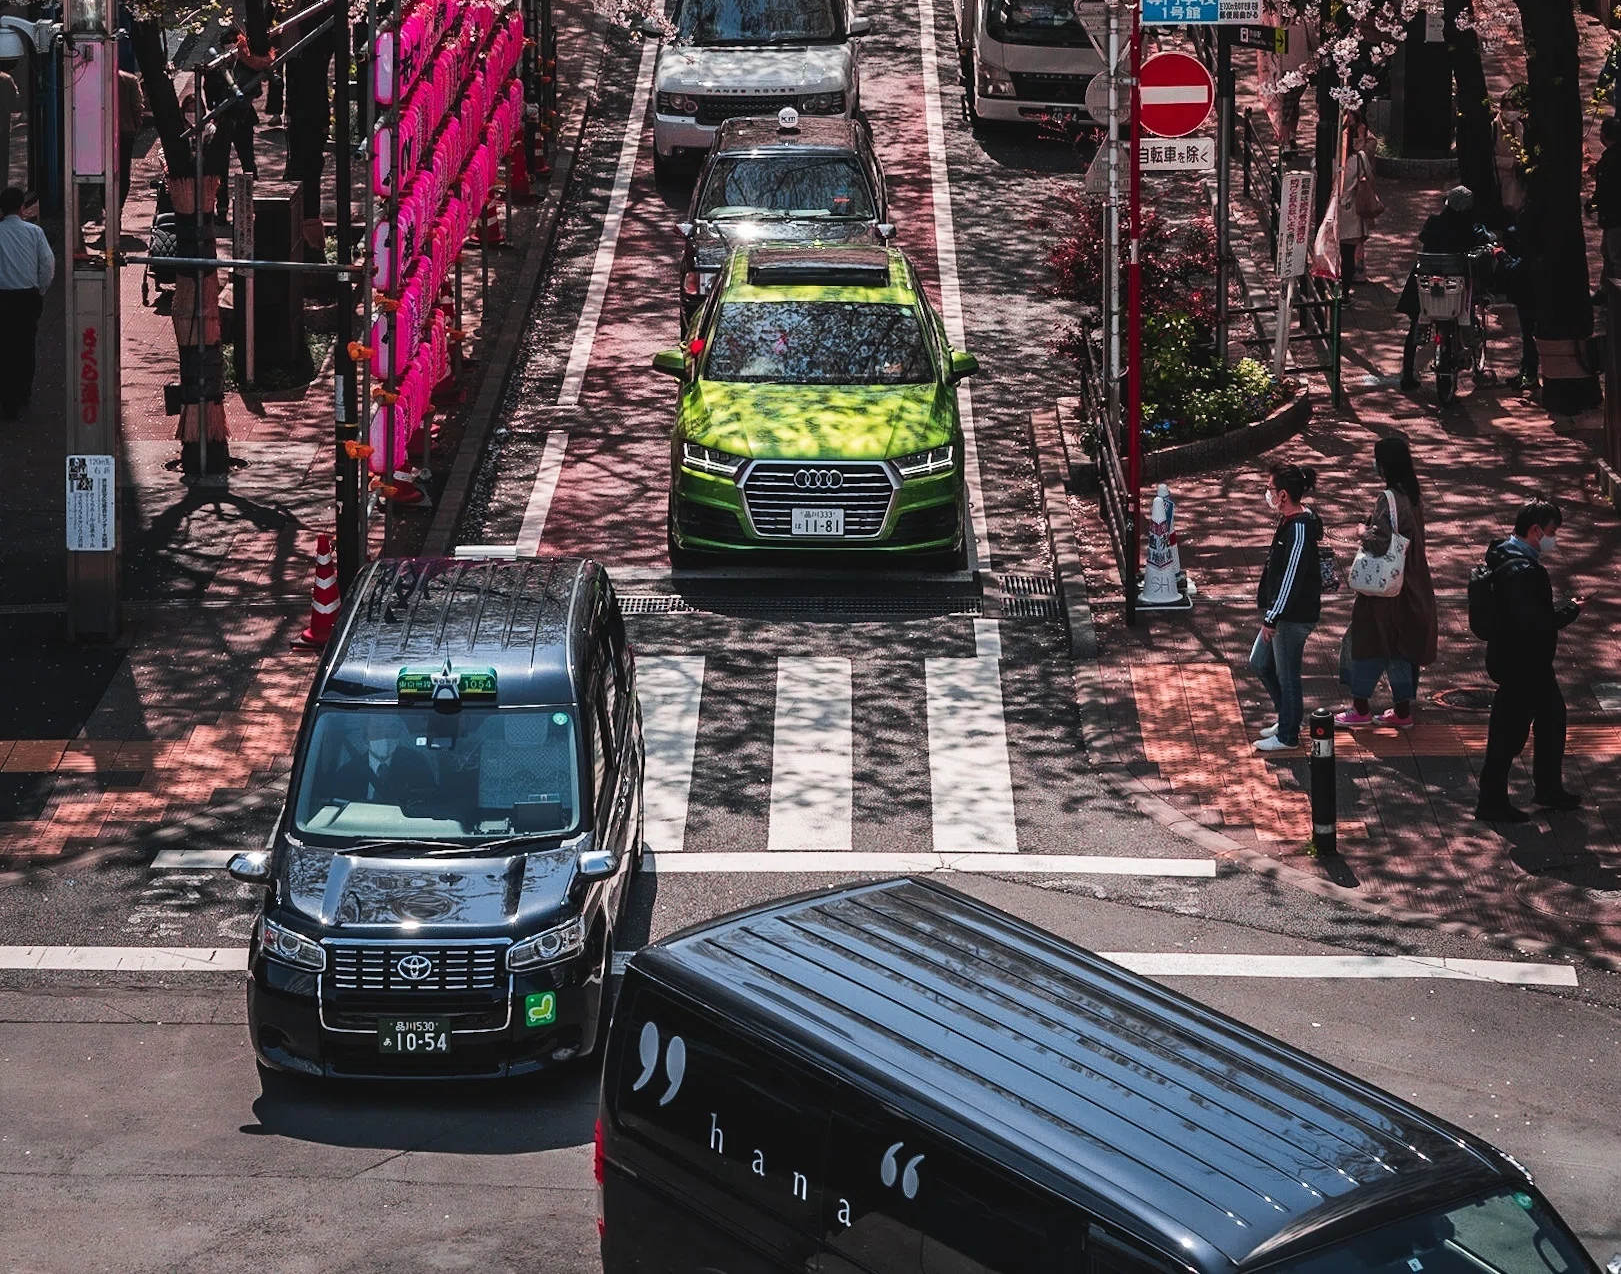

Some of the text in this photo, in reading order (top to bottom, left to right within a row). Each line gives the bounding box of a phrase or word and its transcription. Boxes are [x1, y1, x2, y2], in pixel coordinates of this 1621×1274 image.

[1162, 6, 1201, 19] 1号館
[1140, 146, 1209, 164] 自転車を除く
[81, 327, 99, 425] さくら通り
[806, 519, 839, 532] 11-81
[465, 680, 491, 688] 1054
